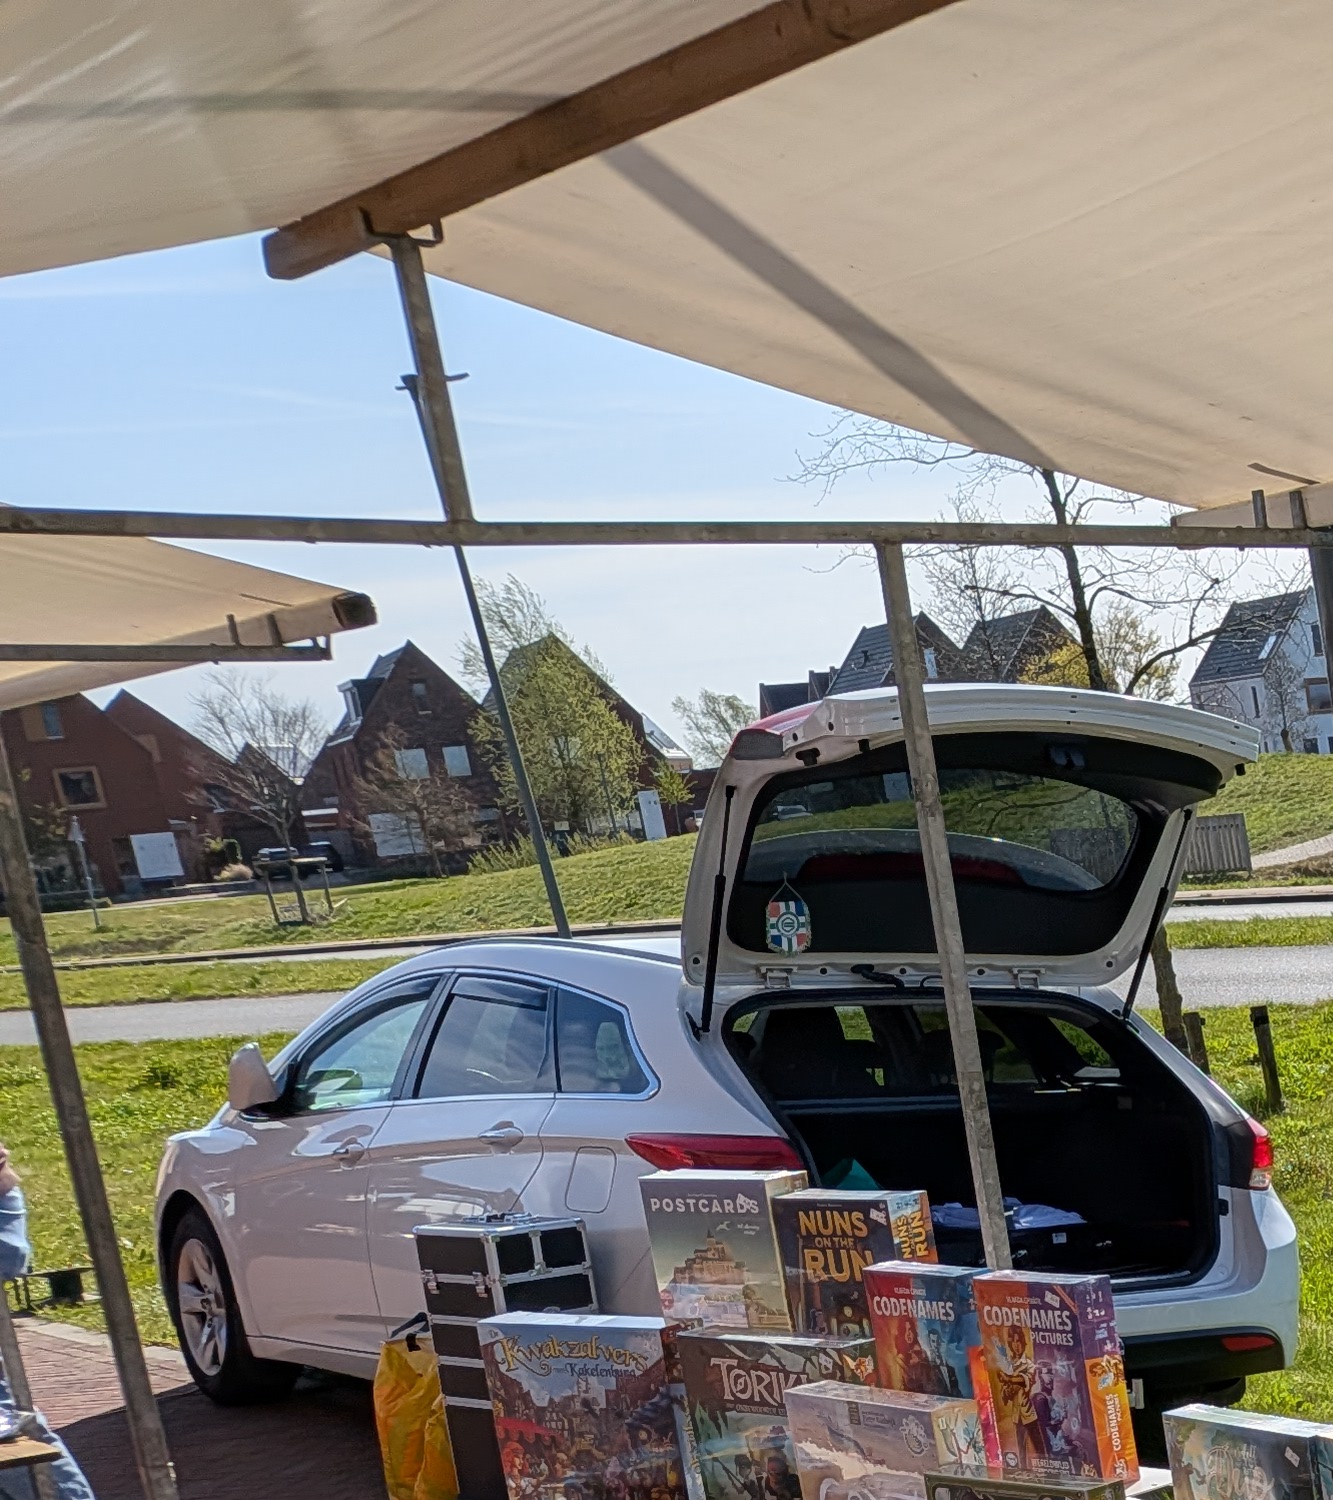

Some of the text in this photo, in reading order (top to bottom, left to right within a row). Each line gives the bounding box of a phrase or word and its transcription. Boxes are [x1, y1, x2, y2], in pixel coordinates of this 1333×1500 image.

[650, 1197, 760, 1214] POSTCARDS
[799, 1209, 869, 1237] NUNS
[896, 1213, 914, 1260] NUNS
[908, 1209, 930, 1258] RUN
[815, 1237, 854, 1248] ON THE
[803, 1248, 874, 1283] RUN
[873, 1295, 955, 1322] CODENAMES
[983, 1305, 1073, 1332] CODENAMES
[1031, 1331, 1074, 1347] PICTURES
[499, 1335, 649, 1374] Kwakzalvers
[1105, 1393, 1122, 1452] CODENAMES
